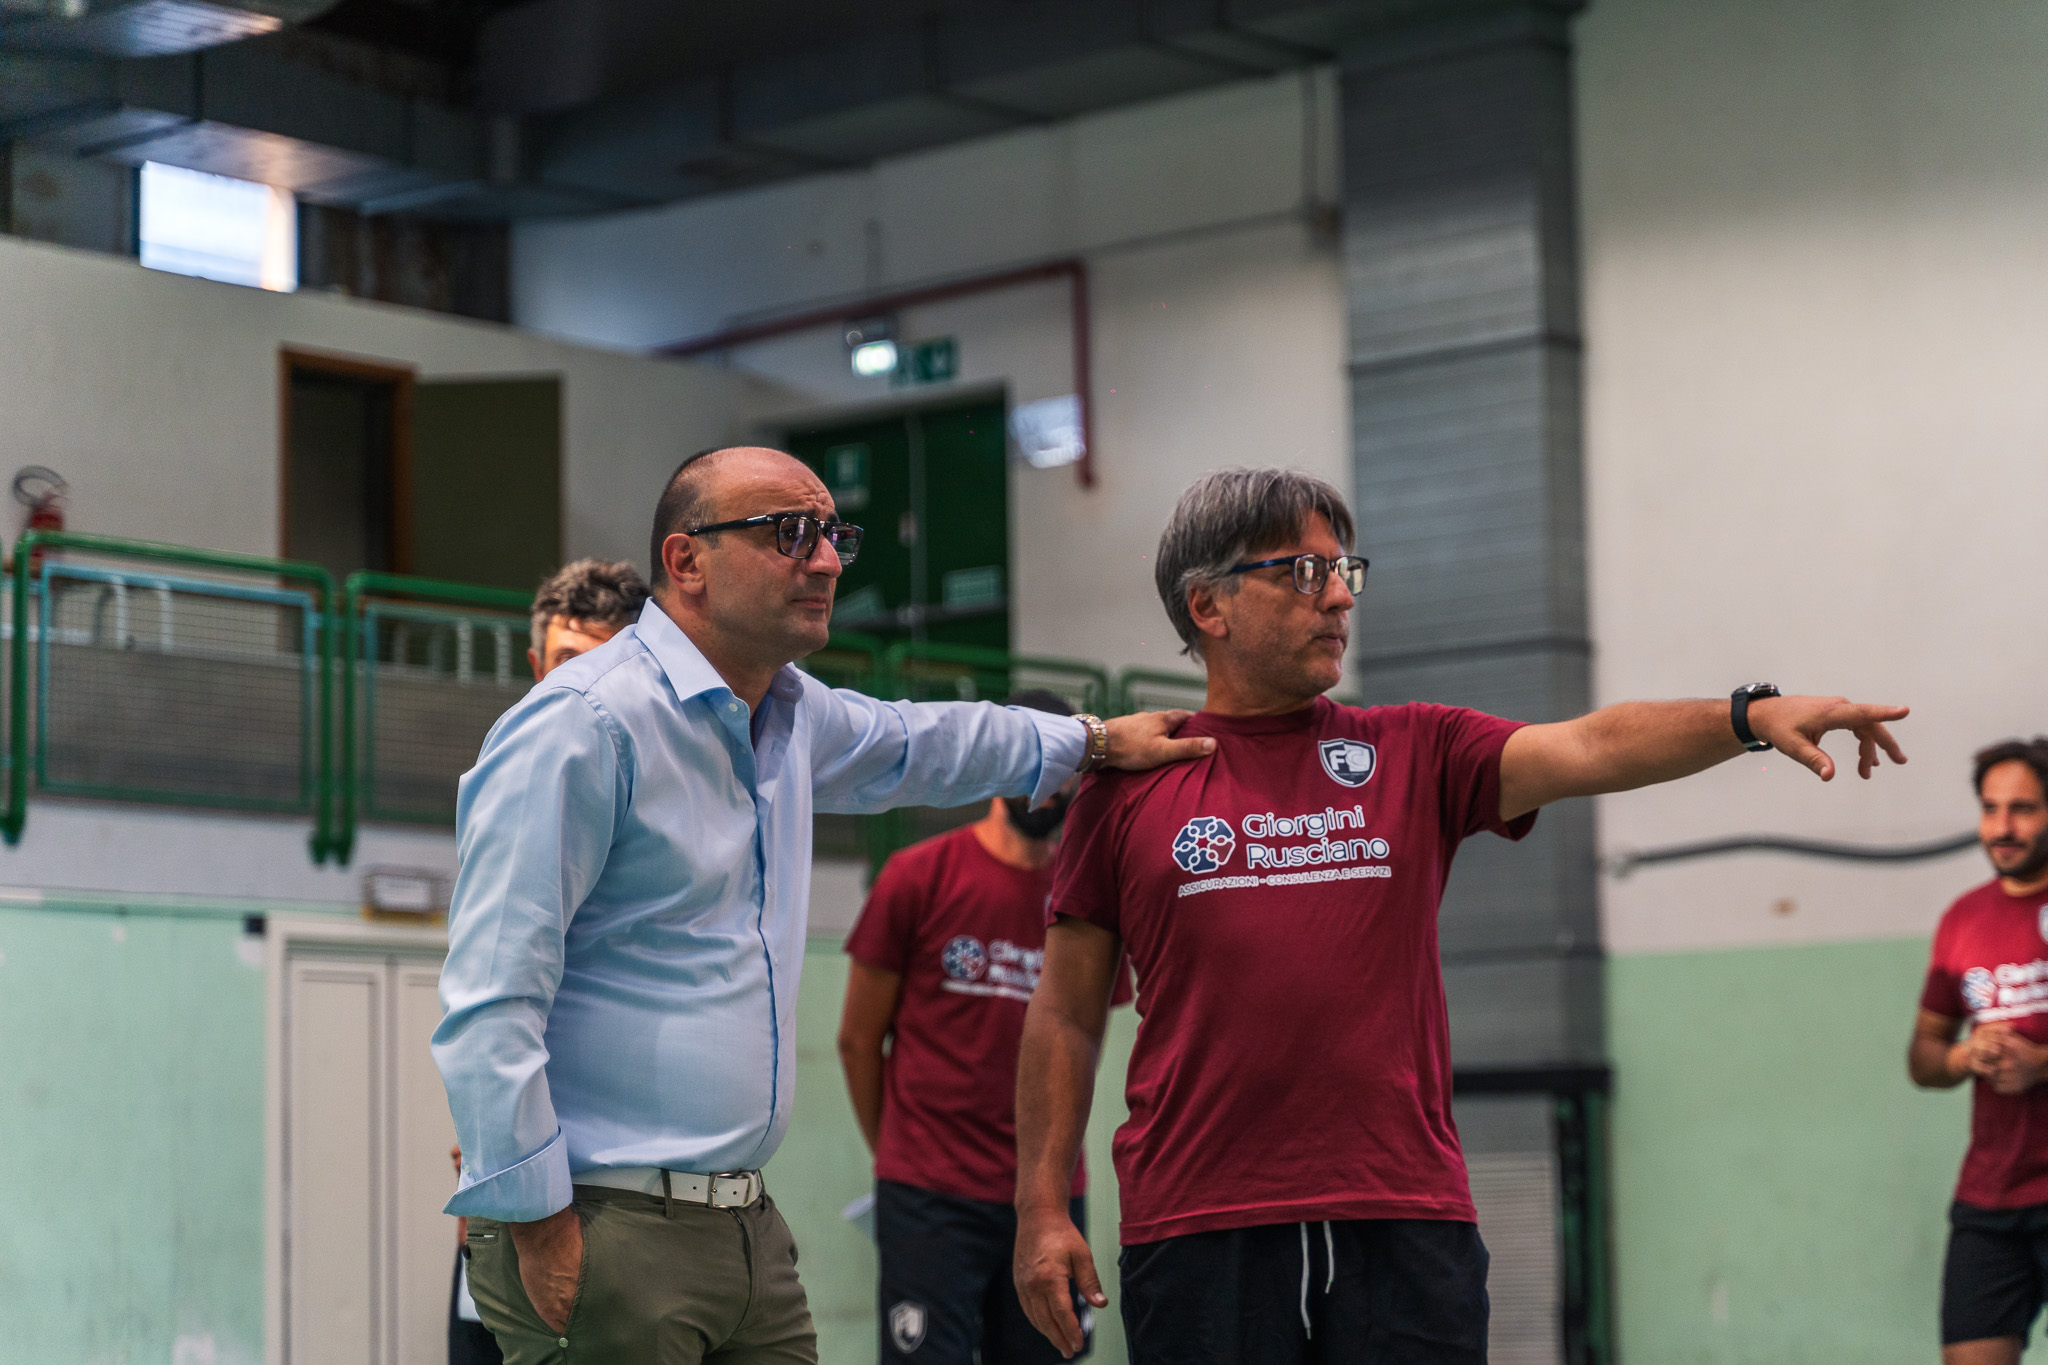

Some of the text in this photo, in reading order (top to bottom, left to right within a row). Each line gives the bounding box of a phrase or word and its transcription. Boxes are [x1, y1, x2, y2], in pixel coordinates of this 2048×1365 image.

[1242, 805, 1366, 838] Giorgini
[1246, 837, 1390, 869] Rusciano
[1178, 876, 1259, 897] ASSICURAZIONI
[1266, 868, 1341, 886] CONSULENZA
[1342, 867, 1351, 878] E
[1351, 866, 1392, 878] SERVIZI
